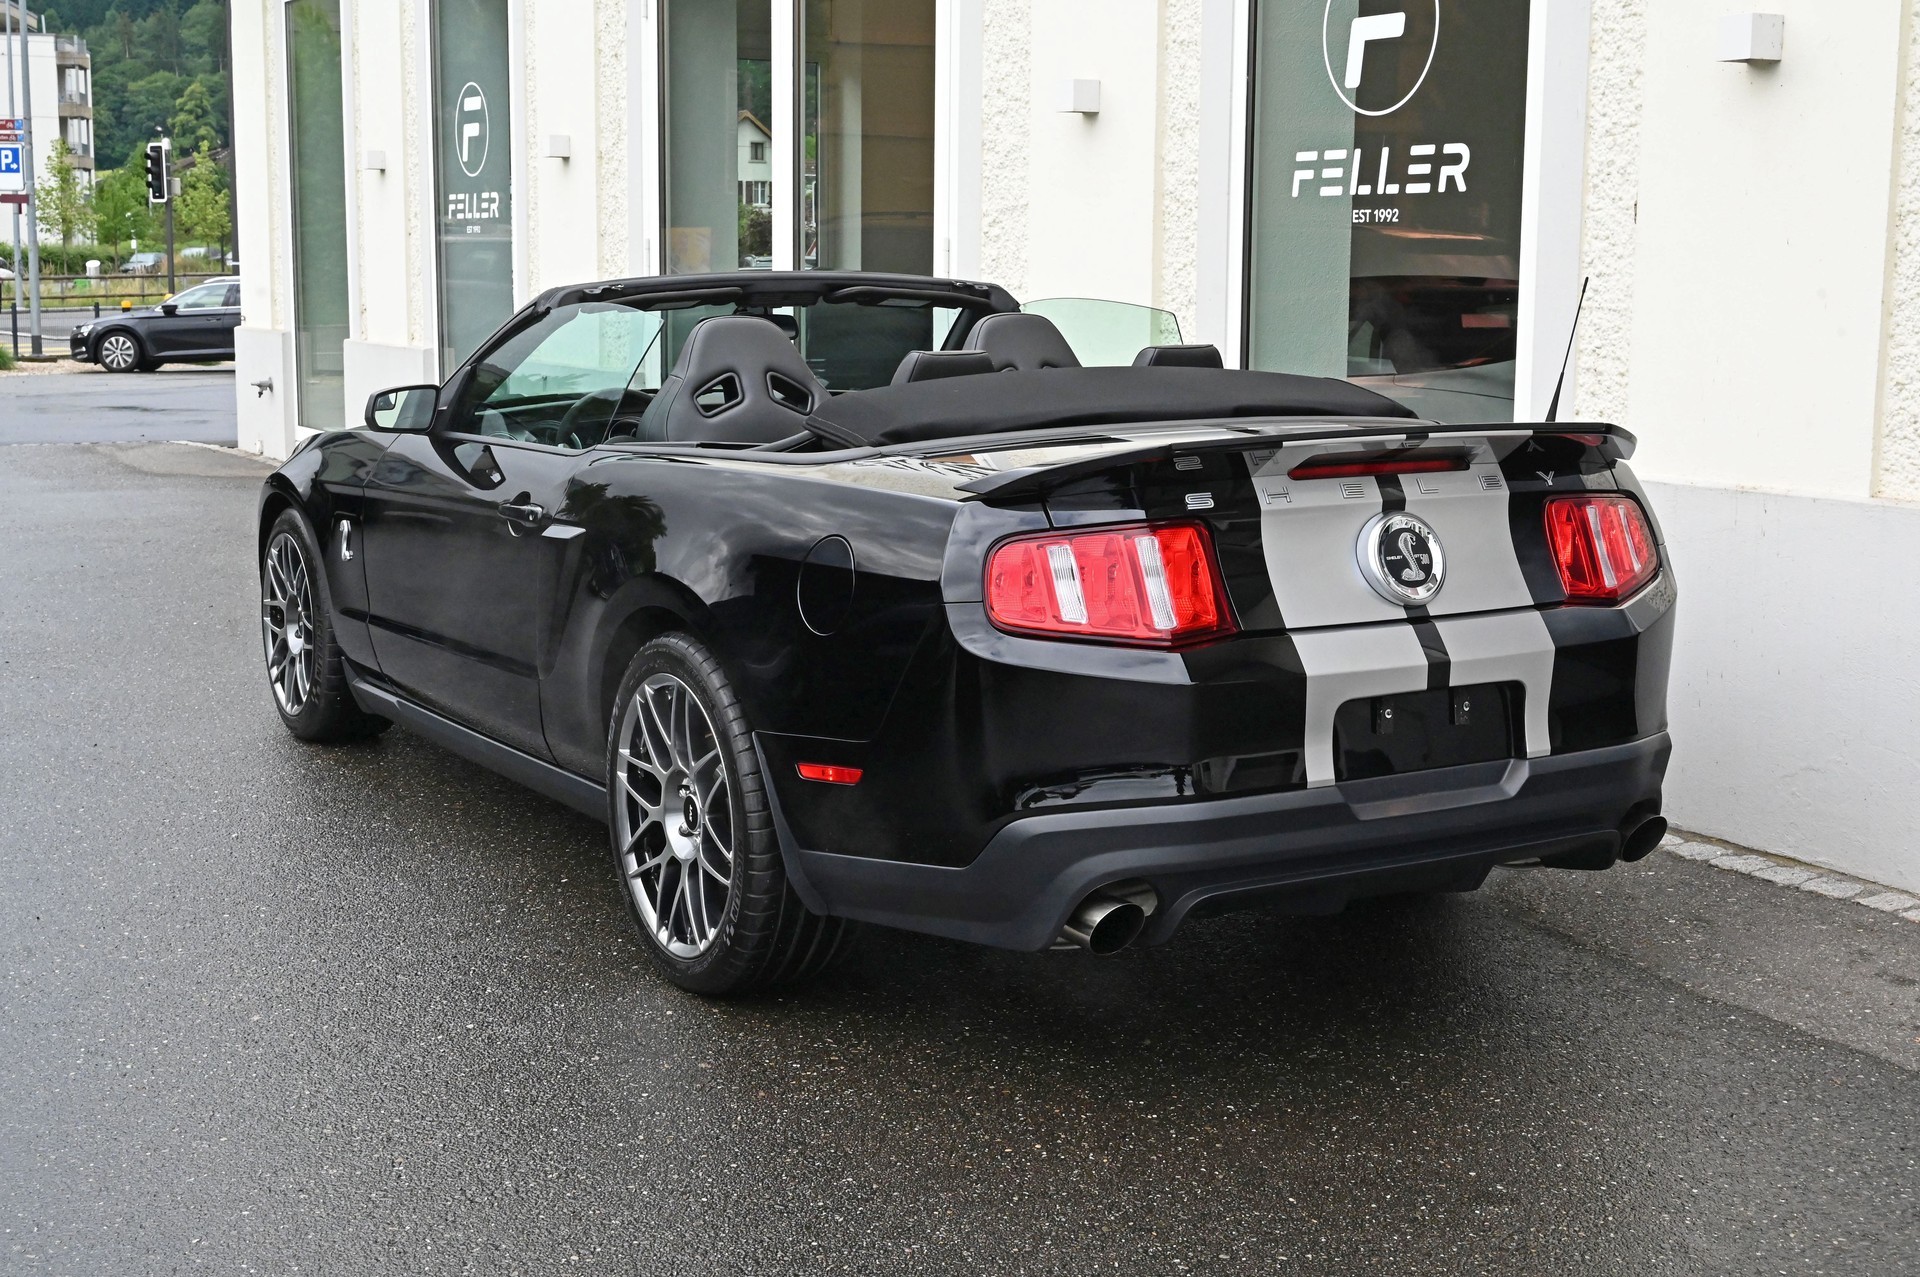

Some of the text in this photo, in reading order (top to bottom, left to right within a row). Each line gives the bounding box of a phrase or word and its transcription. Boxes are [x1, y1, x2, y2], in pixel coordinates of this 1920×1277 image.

[462, 96, 482, 162] F
[1, 150, 12, 170] P
[1292, 143, 1470, 197] FELLER
[449, 192, 499, 219] FELLER
[1352, 208, 1399, 223] EST 1992
[1185, 470, 1556, 510] SHELBY
